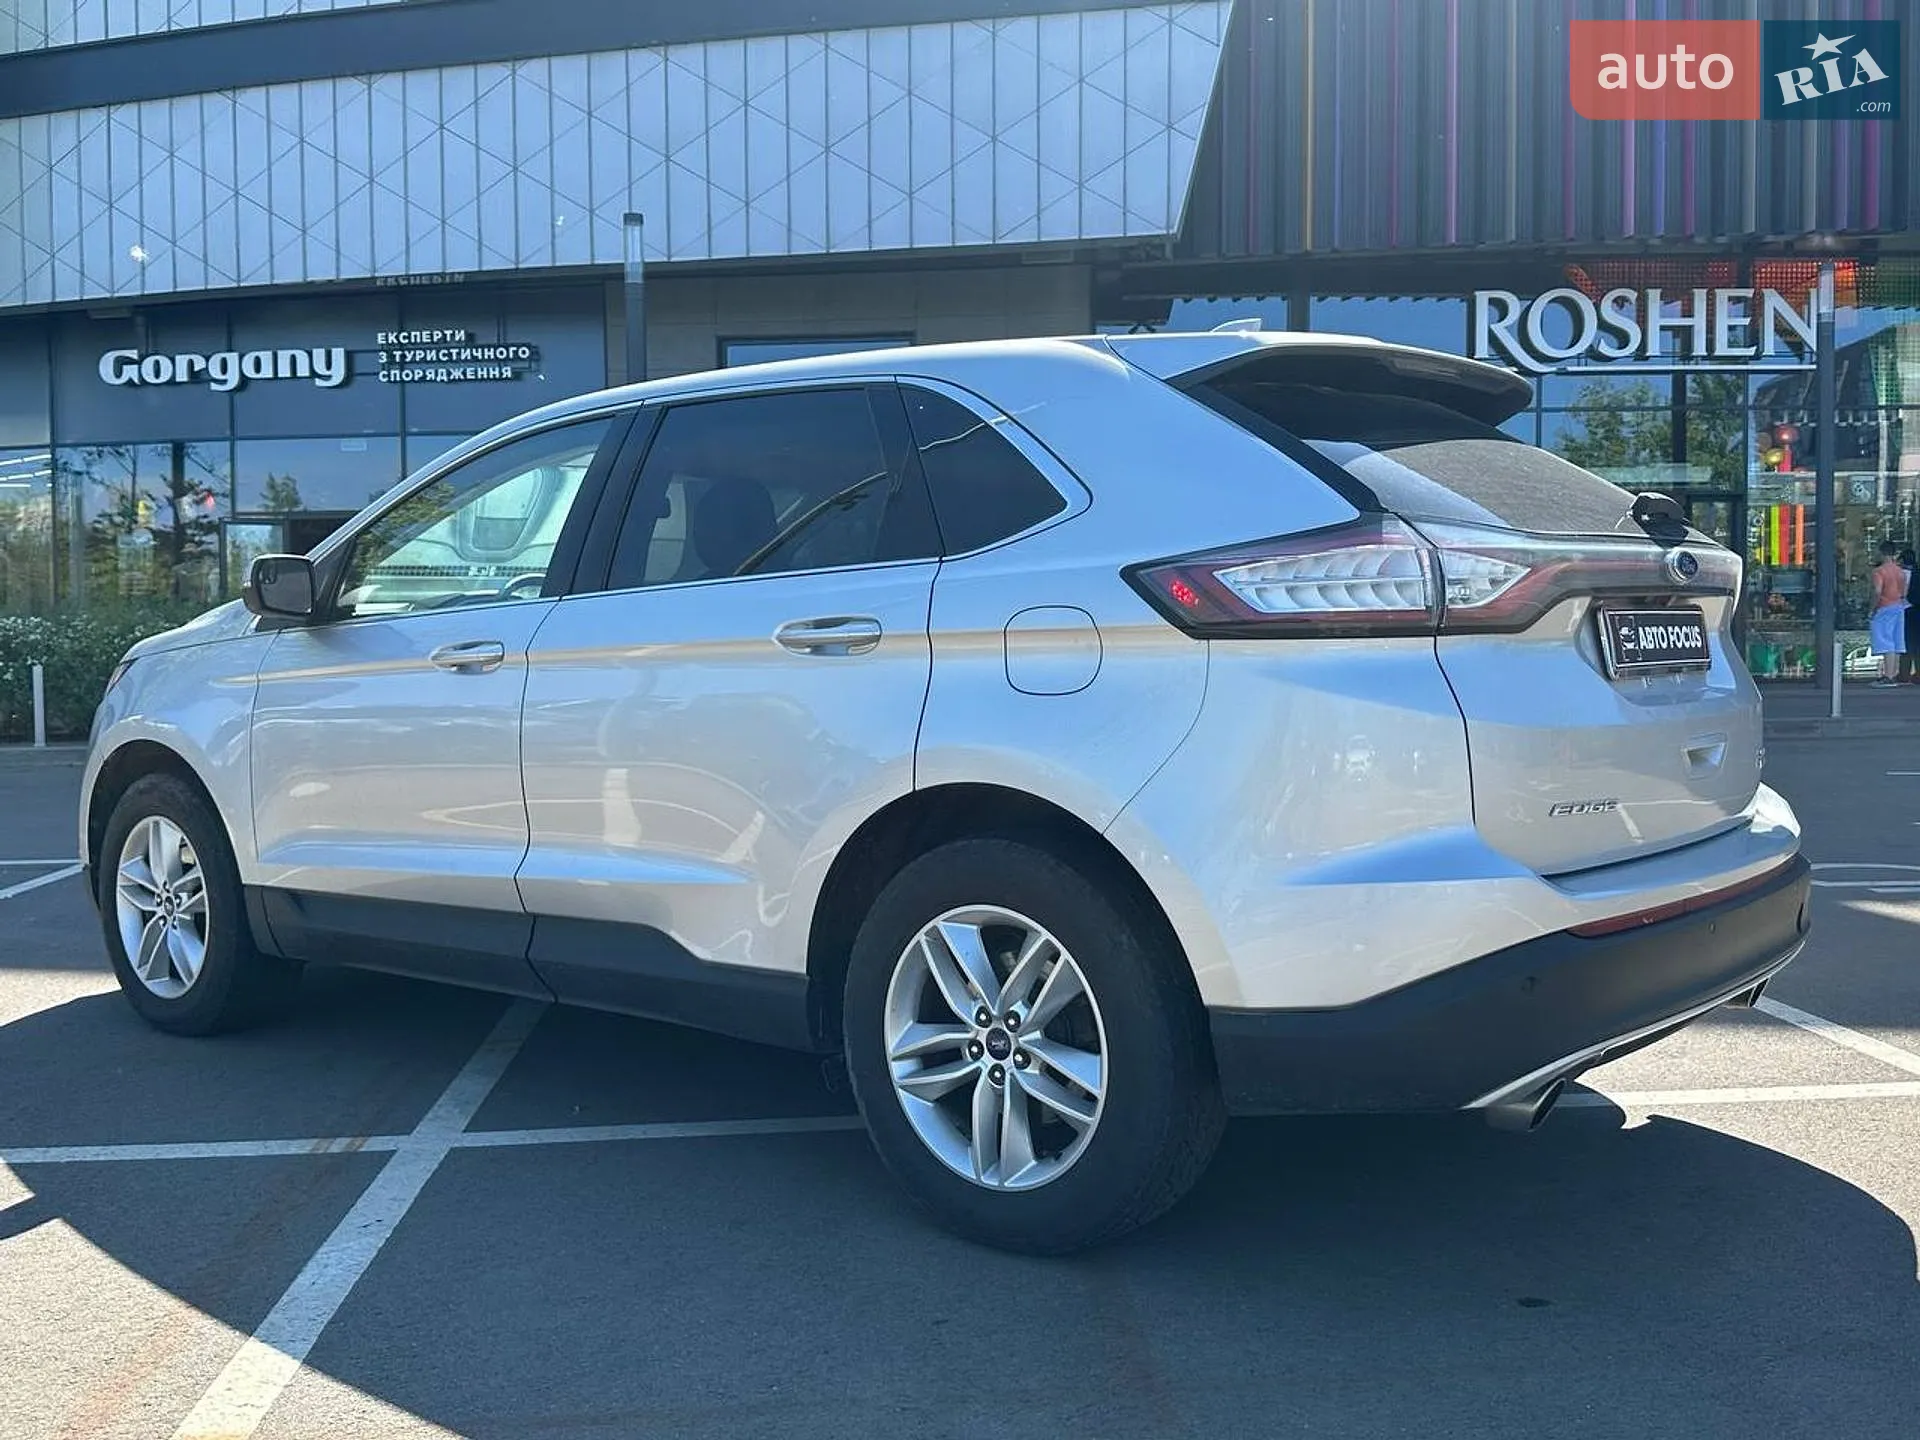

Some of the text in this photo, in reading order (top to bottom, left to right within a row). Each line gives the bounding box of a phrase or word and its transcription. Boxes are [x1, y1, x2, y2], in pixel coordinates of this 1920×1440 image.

[376, 329, 466, 345] ЕКСПЕРТИ
[1473, 288, 1818, 373] ROSHEN
[393, 346, 530, 363] ТУРИСТИЧНОГО
[98, 347, 345, 392] Gorgany
[378, 366, 512, 383] СПОРЯДЖЕННЯ
[1667, 625, 1702, 649] FOCUS
